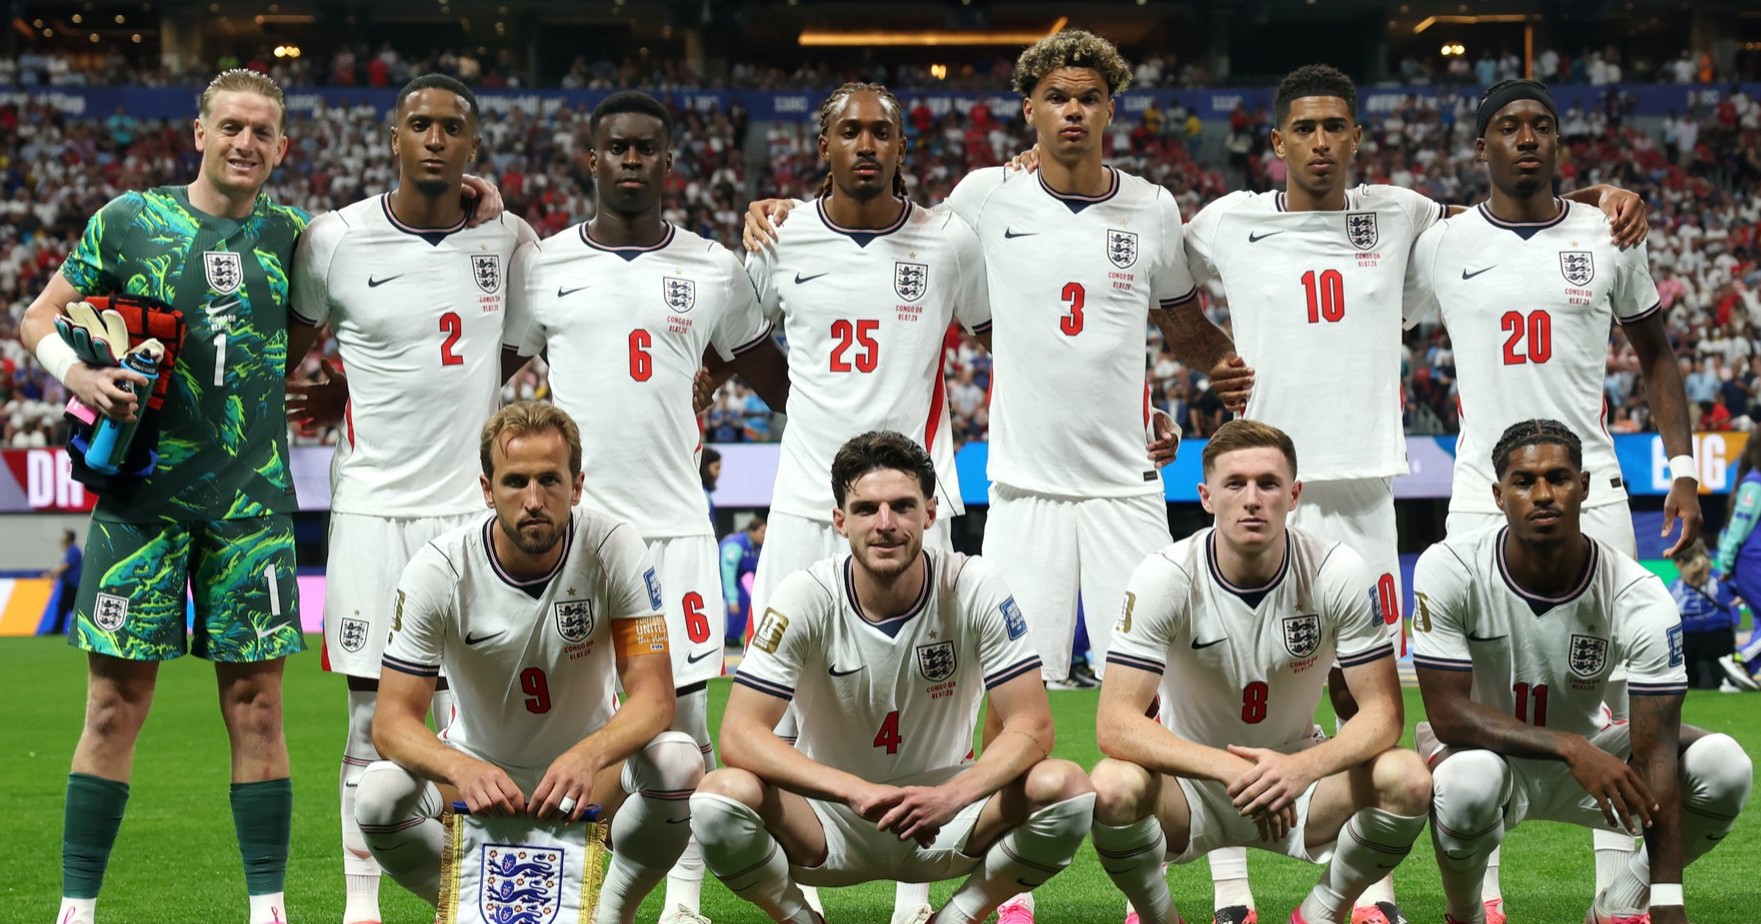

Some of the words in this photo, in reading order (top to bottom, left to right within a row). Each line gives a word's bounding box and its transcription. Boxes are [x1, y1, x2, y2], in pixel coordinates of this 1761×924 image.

[1108, 272, 1126, 280] CONGO
[1300, 269, 1345, 324] 10
[1564, 288, 1584, 296] CONGO
[667, 316, 685, 326] CONGO
[896, 305, 914, 313] CONGO
[915, 306, 923, 314] DR
[1060, 282, 1085, 336] 3
[214, 333, 226, 386] 1
[440, 312, 464, 366] 2
[629, 329, 652, 382] 6
[830, 319, 879, 373] 25
[1501, 310, 1552, 366] 20
[27, 449, 84, 508] DR
[264, 563, 280, 616] 1
[1378, 572, 1399, 625] 0
[682, 591, 710, 644] 6
[564, 643, 585, 653] CONGO
[586, 640, 594, 648] DR
[1290, 659, 1310, 668] CONGO
[520, 666, 551, 715] 9
[927, 683, 947, 693] CONGO
[1242, 681, 1268, 724] 8
[1513, 682, 1548, 727] 11
[873, 710, 902, 755] 4
